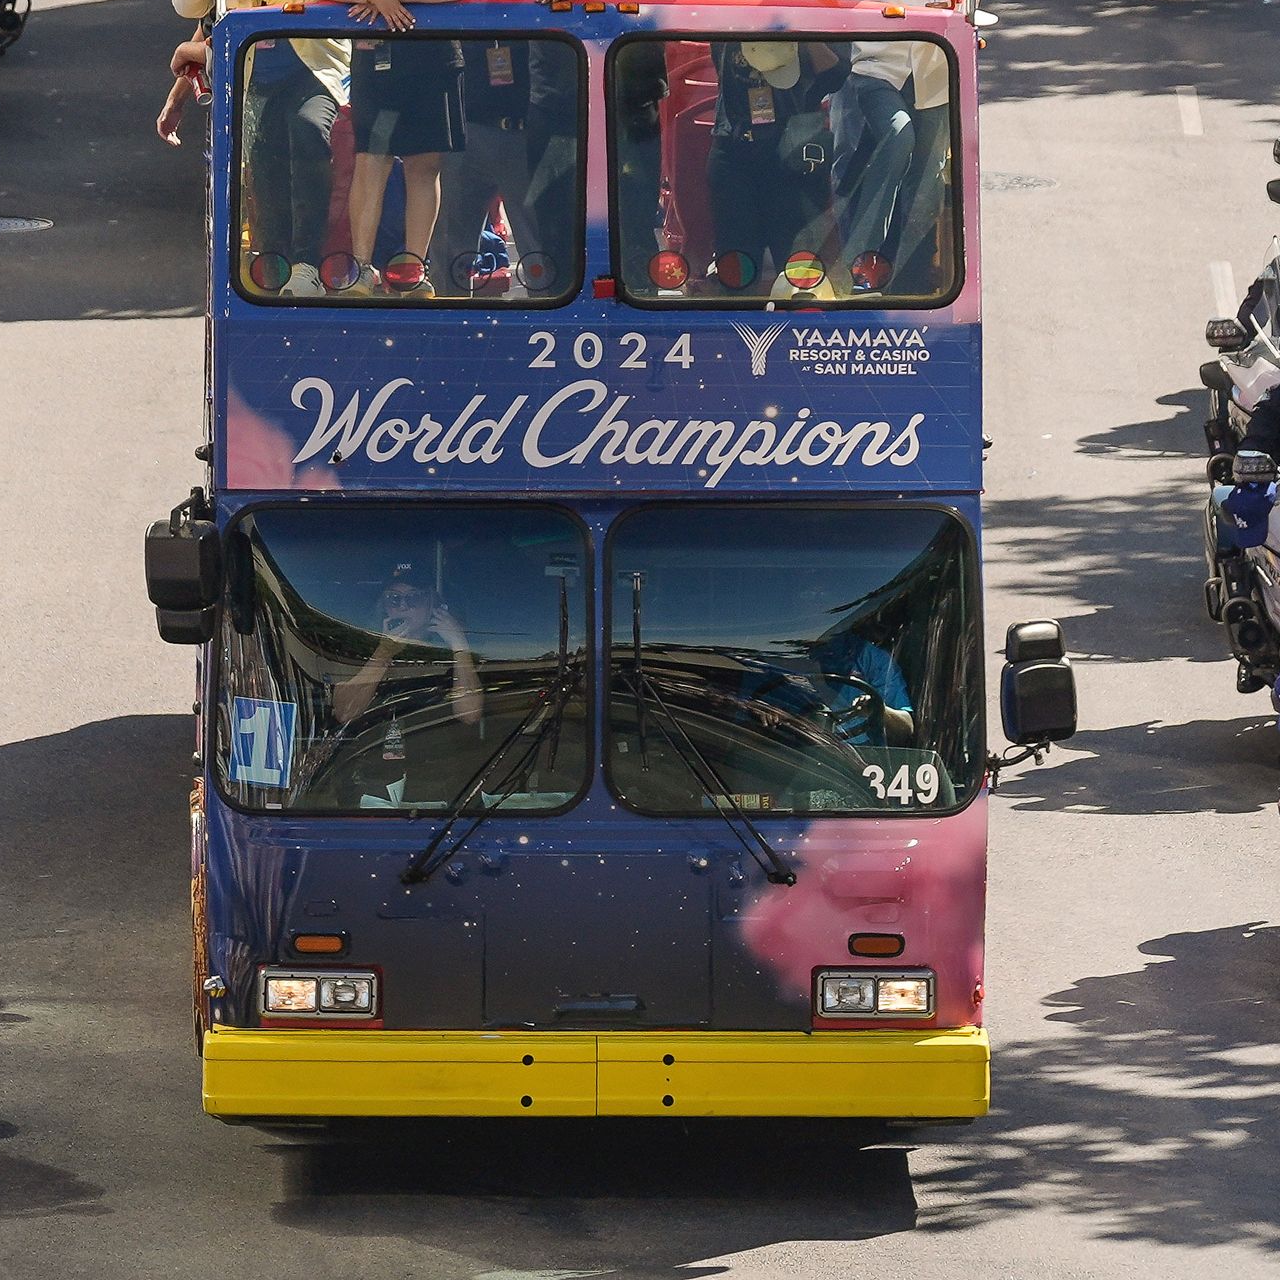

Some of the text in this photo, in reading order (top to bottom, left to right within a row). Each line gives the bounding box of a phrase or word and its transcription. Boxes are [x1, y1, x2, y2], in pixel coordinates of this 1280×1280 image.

[527, 331, 695, 369] 2024
[789, 349, 931, 362] RESORT & CASINO
[814, 363, 847, 376] SAN
[850, 363, 918, 376] MANUEL
[290, 376, 925, 489] World Champions
[235, 706, 282, 786] 1
[861, 763, 940, 806] 349
